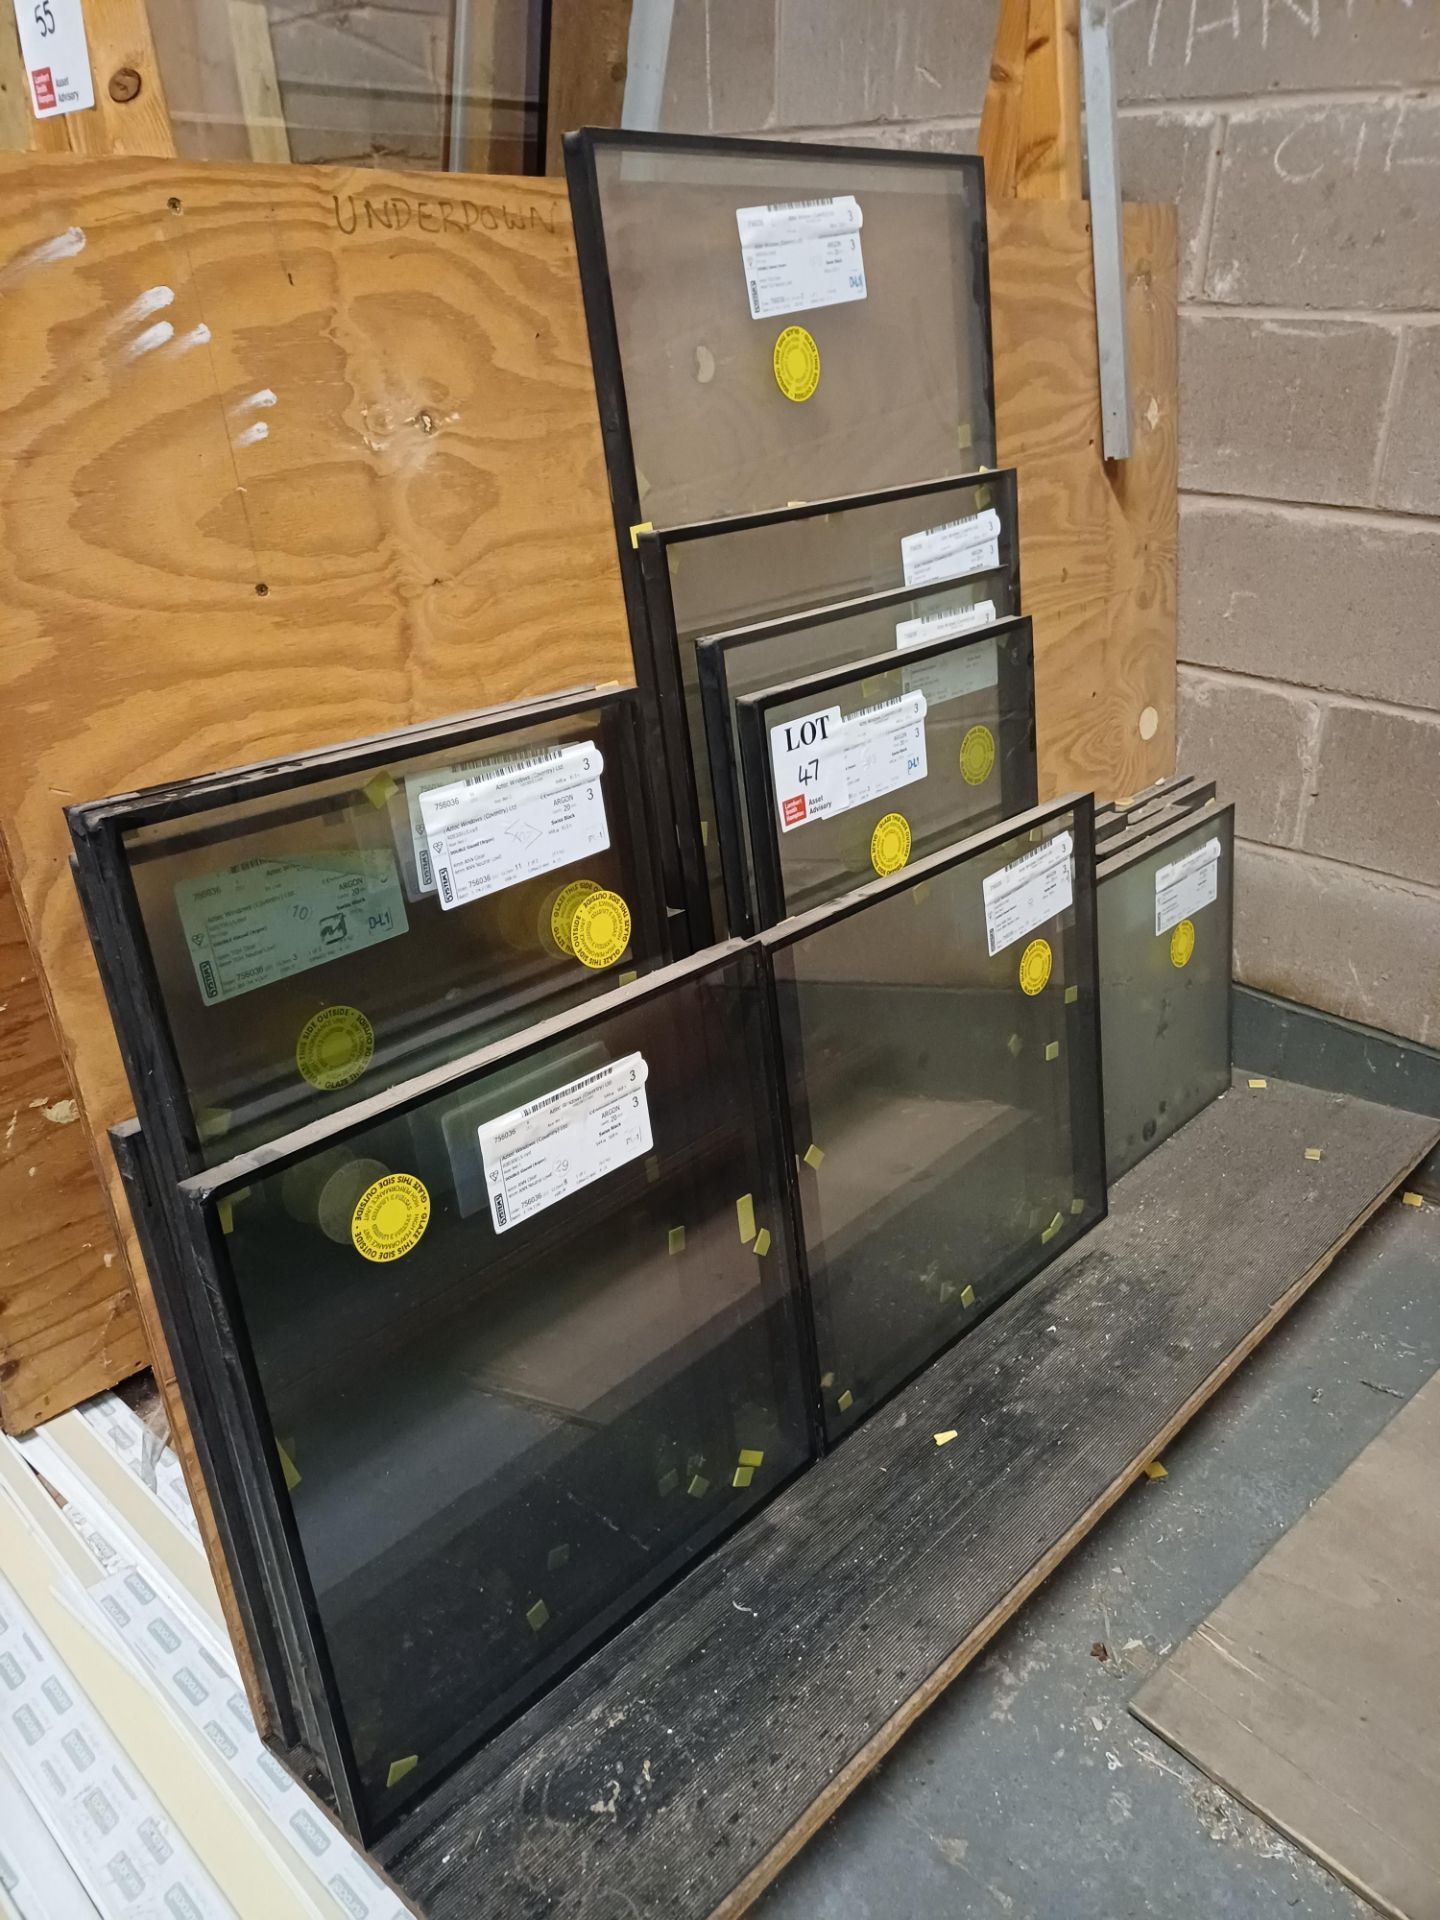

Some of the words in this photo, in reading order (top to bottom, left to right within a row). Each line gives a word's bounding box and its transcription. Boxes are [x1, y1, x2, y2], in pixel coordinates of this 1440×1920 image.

[34, 0, 55, 37] 55
[332, 194, 558, 235] UNDERDOWN
[784, 715, 829, 752] LOT
[582, 757, 591, 771] 3
[799, 758, 819, 786] 47
[553, 794, 574, 807] ARGON
[586, 787, 594, 801] 3
[808, 794, 824, 806] Asset
[809, 801, 832, 815] Advisory
[339, 878, 363, 890] ARGON
[292, 904, 310, 921] 10
[317, 1007, 349, 1023] OUTSIDE
[629, 1069, 637, 1081] 3
[632, 1095, 640, 1108] 3
[378, 1176, 396, 1189] SIDE
[397, 1175, 414, 1186] THIS
[412, 1182, 428, 1204] GLAZE
[354, 1187, 378, 1221] OUTSIDE
[412, 1212, 428, 1239] GLAZE
[354, 1231, 378, 1258] OUTSIDE
[397, 1239, 414, 1255] THIS
[377, 1250, 396, 1260] SIDE
[173, 1668, 206, 1701] eurocell
[203, 1725, 235, 1759] eurocell
[291, 1812, 328, 1850] eurocell
